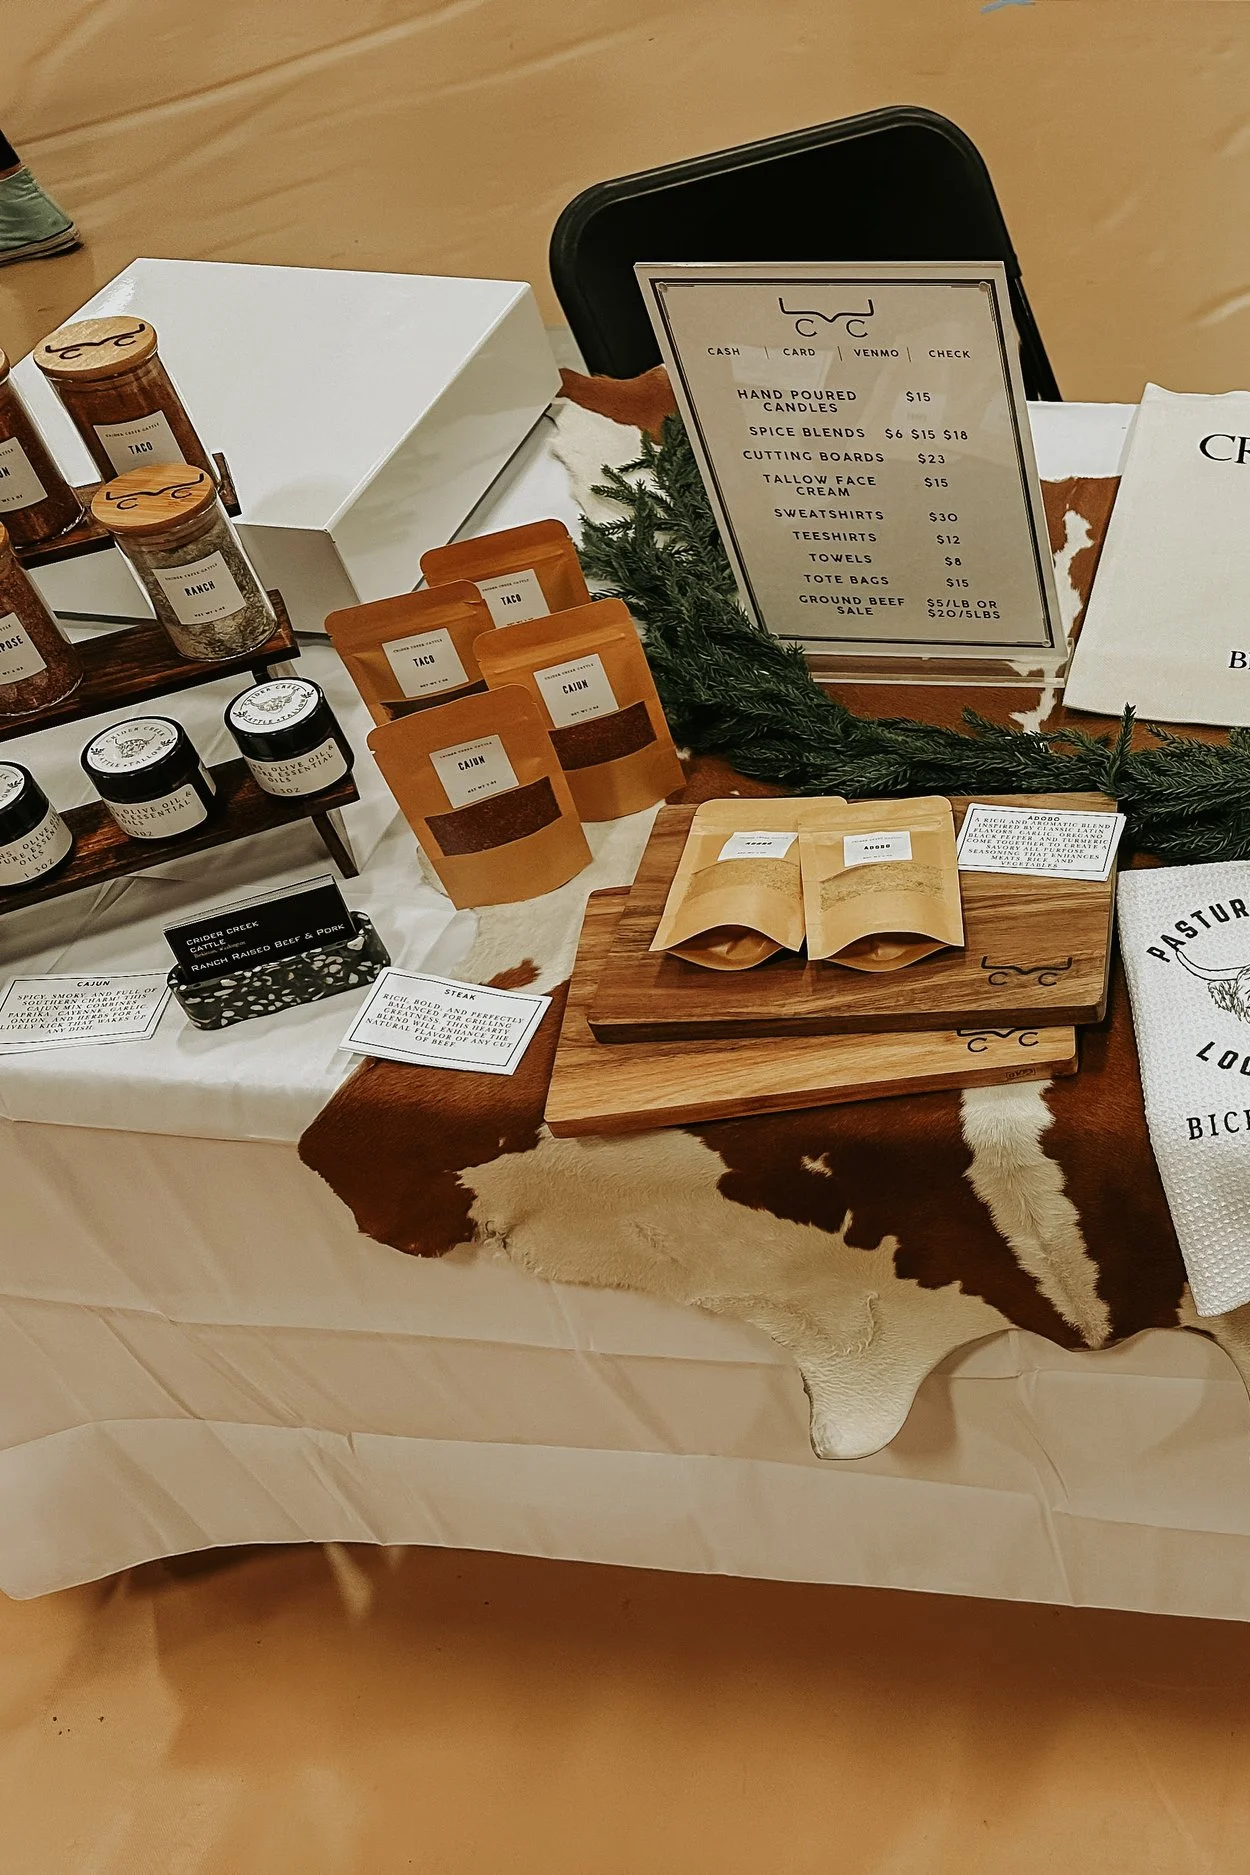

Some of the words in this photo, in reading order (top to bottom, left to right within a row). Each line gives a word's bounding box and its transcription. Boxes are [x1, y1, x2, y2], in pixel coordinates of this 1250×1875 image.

[783, 348, 815, 356] CARD
[929, 350, 970, 358] CHECK
[737, 390, 782, 399] HAND
[791, 391, 856, 400] POURED
[906, 391, 931, 402] $15
[764, 403, 837, 412] CANDLES
[750, 427, 795, 436] SPICE
[802, 428, 865, 437] BLENDS
[885, 429, 902, 439] $6
[912, 429, 935, 439] $15
[944, 430, 968, 440] $18
[128, 442, 153, 454] TACO
[743, 451, 812, 461] CUTTING
[820, 452, 884, 462] BOARDS
[918, 453, 945, 463] $23
[763, 474, 827, 484] TALLOW
[836, 476, 876, 485] FACE
[925, 478, 948, 487] $15
[796, 487, 850, 496] CREAM
[775, 509, 883, 520] SWEATSHIRTS
[929, 512, 957, 522] $30
[793, 532, 876, 541] TEESHIRTS
[937, 535, 960, 544] $12
[809, 554, 872, 563] TOWELS
[945, 557, 961, 566] $8
[804, 575, 843, 583] TOTE
[850, 576, 889, 584] BAGS
[947, 578, 968, 587] $15
[184, 581, 215, 596] RANCH
[501, 594, 522, 605] TACO
[799, 595, 861, 604] GROUND
[869, 597, 904, 606] BEEF
[927, 599, 969, 608] $5/LB
[837, 607, 873, 615] SALE
[928, 609, 1000, 619] $20/5LBS
[0, 635, 23, 652] POSE
[413, 655, 435, 667] TACO
[562, 680, 589, 694] CAJUN
[271, 763, 303, 772] OLIVE
[308, 752, 324, 763] OIL
[278, 754, 332, 777] ESSENTIAL
[458, 756, 486, 771] CAJUN
[186, 931, 223, 946] CRIDER
[226, 921, 259, 935] CREEK
[190, 939, 226, 953] CATTLE
[444, 989, 476, 1000] STEAK
[432, 1039, 456, 1047] BEEF
